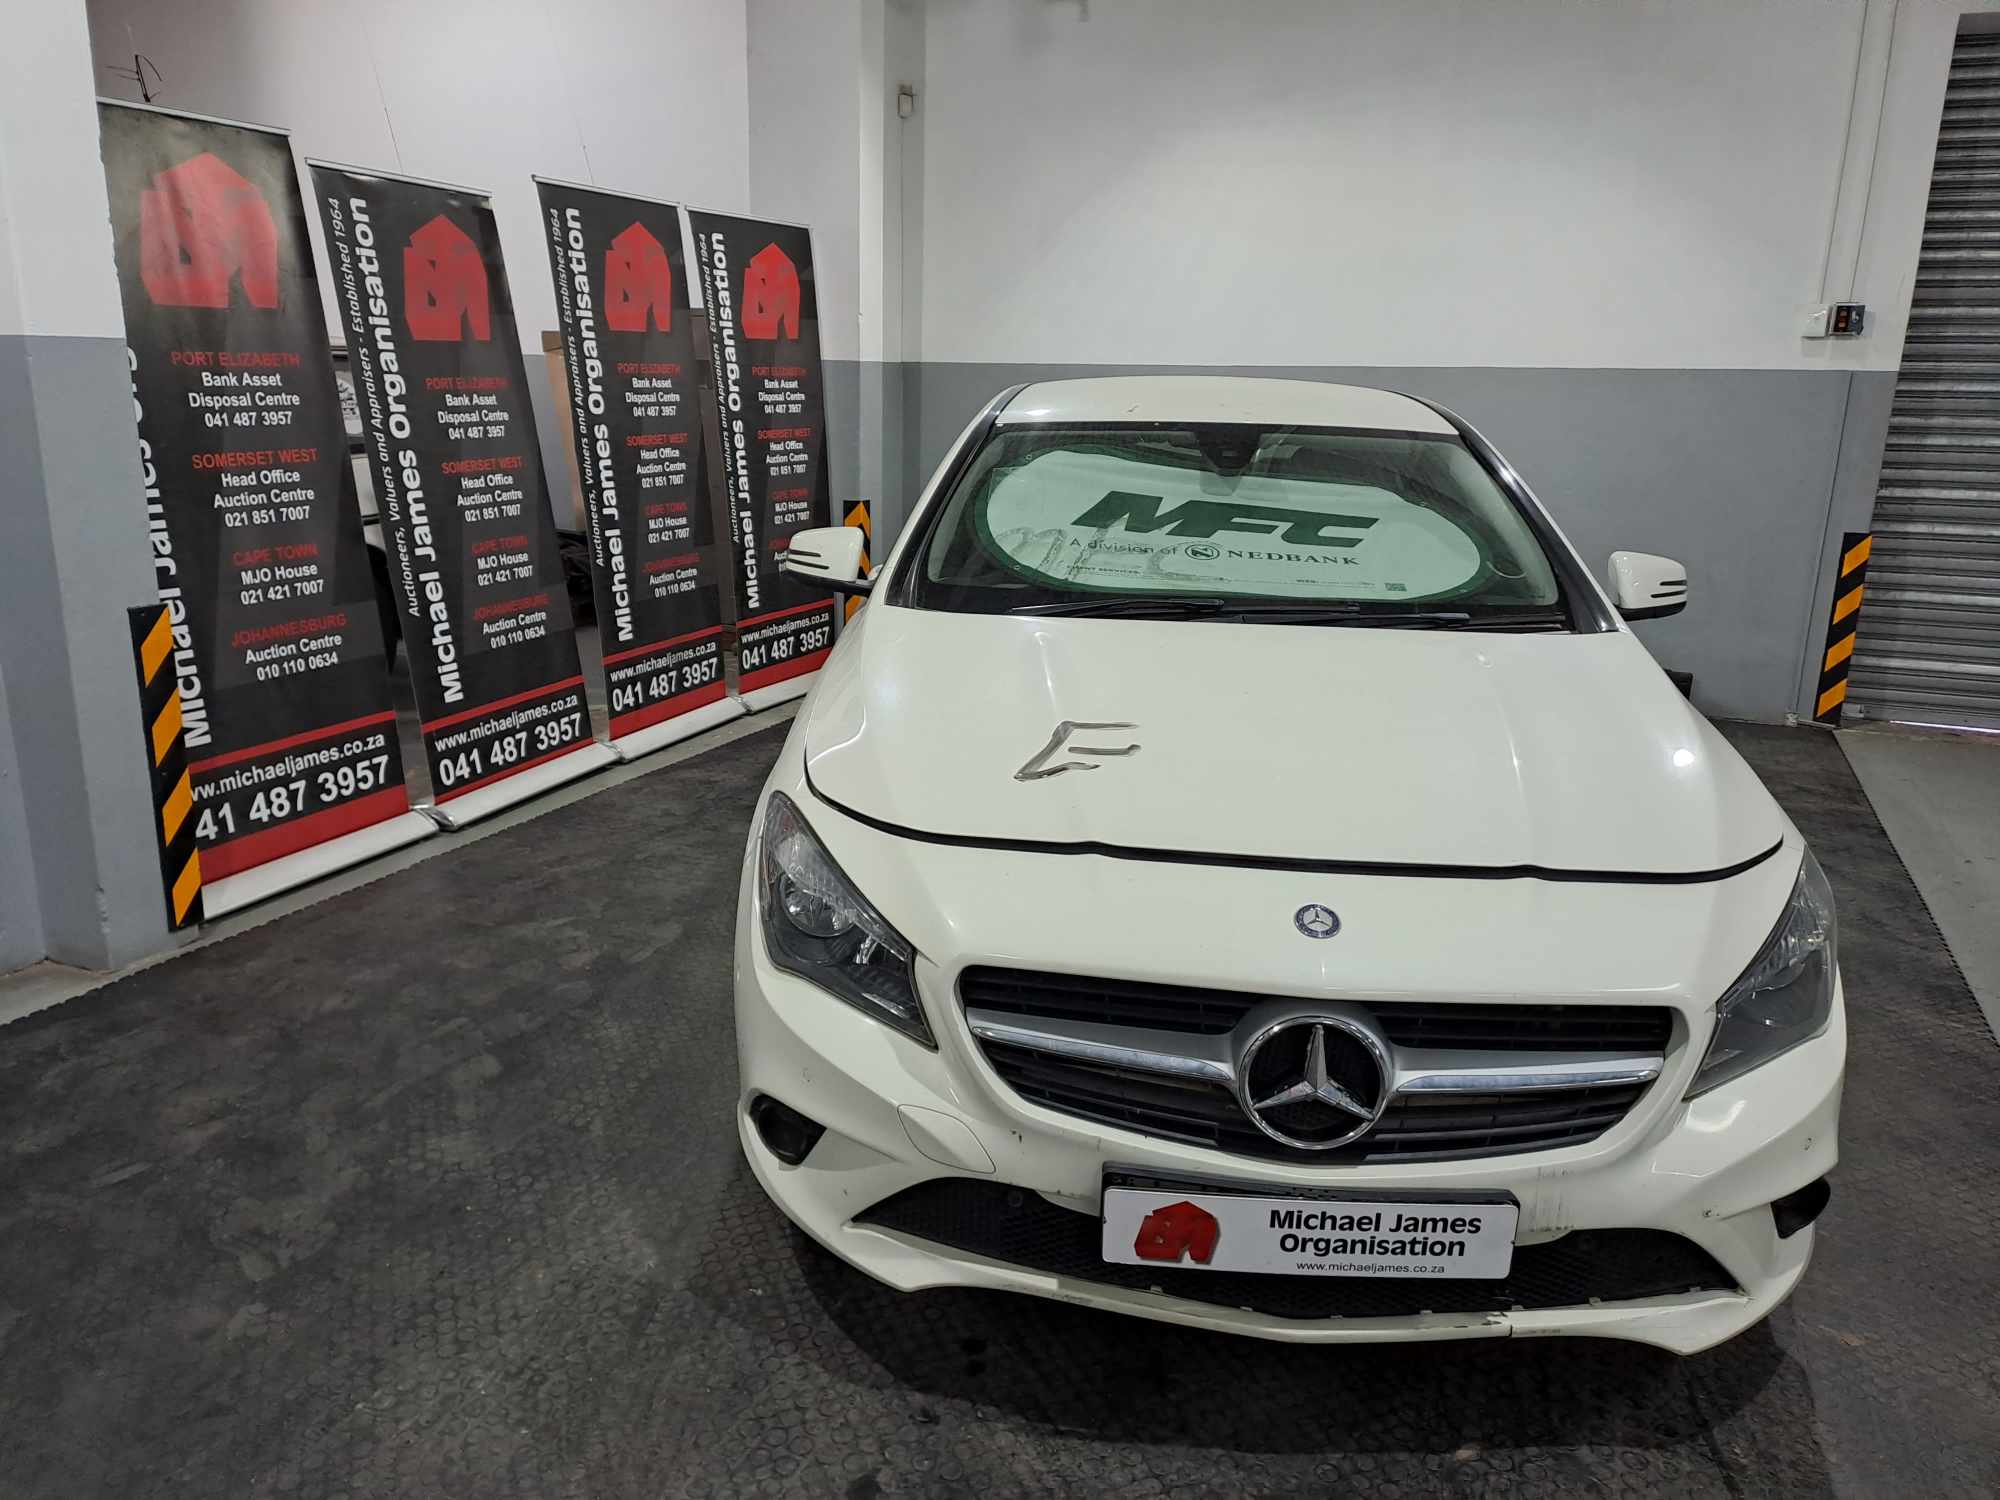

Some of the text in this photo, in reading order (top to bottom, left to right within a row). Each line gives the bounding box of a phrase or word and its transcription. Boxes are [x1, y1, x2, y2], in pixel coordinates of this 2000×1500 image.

[555, 245, 573, 324] Established
[170, 350, 301, 367] PORT ELIZABETH
[202, 371, 282, 388] Bank Asset
[568, 335, 584, 405] Appraisers
[632, 377, 671, 388] Bank Asset
[188, 392, 300, 409] Disposal Centre
[328, 197, 420, 617] Auctioneers, Valuers and Appraisers Established 1964
[445, 394, 496, 407] Bank Asset
[625, 392, 680, 403] Disposal Centre
[205, 411, 292, 428] 041 487 3957
[438, 409, 509, 425] Disposal Centre
[575, 408, 586, 433] and
[633, 405, 676, 417] 041 487 3957
[712, 232, 760, 609] Michael James Organisation
[449, 425, 505, 440] 041 487 3957
[566, 208, 634, 642] Michael James Organisation
[191, 448, 319, 470] SOMERSET WEST
[350, 197, 465, 704] Michael James Organisation
[580, 437, 592, 484] Valuers
[640, 448, 679, 459] Head Office
[441, 457, 497, 474] SOMERSET
[636, 461, 686, 475] Auction Centre
[222, 469, 301, 489] Head Office
[461, 473, 513, 489] Head Office
[642, 477, 653, 488] 021
[655, 476, 667, 487] 851
[213, 488, 315, 510] Auction Centre
[456, 489, 523, 507] Auction Centre
[225, 506, 310, 528] 021 851 7007
[465, 504, 521, 522] 021 851 7007
[665, 516, 687, 526] House
[1070, 490, 1379, 548] MFC
[588, 489, 605, 567] Auctioneers,
[233, 543, 319, 567] CAPE TOWN
[477, 552, 528, 570] MJO House
[1070, 538, 1081, 547] A
[1088, 539, 1154, 554] division
[1228, 550, 1360, 566] NEDBANK
[241, 563, 318, 585] MJO House
[478, 565, 533, 586] 021 421 7007
[649, 568, 698, 585] Auction Centre
[241, 579, 324, 605] 021 421 7007
[654, 587, 667, 598] 010
[668, 584, 679, 596] 110
[232, 613, 346, 647] JOHANNESBURG
[483, 610, 546, 635] Auction Centre
[741, 613, 829, 644] www.michaeljames.co.za
[245, 633, 342, 664] Auction Centre
[490, 626, 546, 649] 010 110 0634
[742, 626, 829, 669] 041 487 3957
[257, 652, 338, 681] 010 110 0634
[610, 641, 716, 682] www.michaeljames.co.za
[612, 657, 718, 713] 041 487 3957
[434, 694, 578, 754] www.michaeljames.co.za
[439, 712, 583, 787] 041 487 3957
[192, 733, 385, 801] ww.michaeljames.co.za
[195, 754, 389, 840] 41 487 3957
[1269, 1209, 1482, 1234] Michael James
[1280, 1232, 1465, 1258] Organisation
[1296, 1261, 1445, 1275] www.michaeljames.co.za
